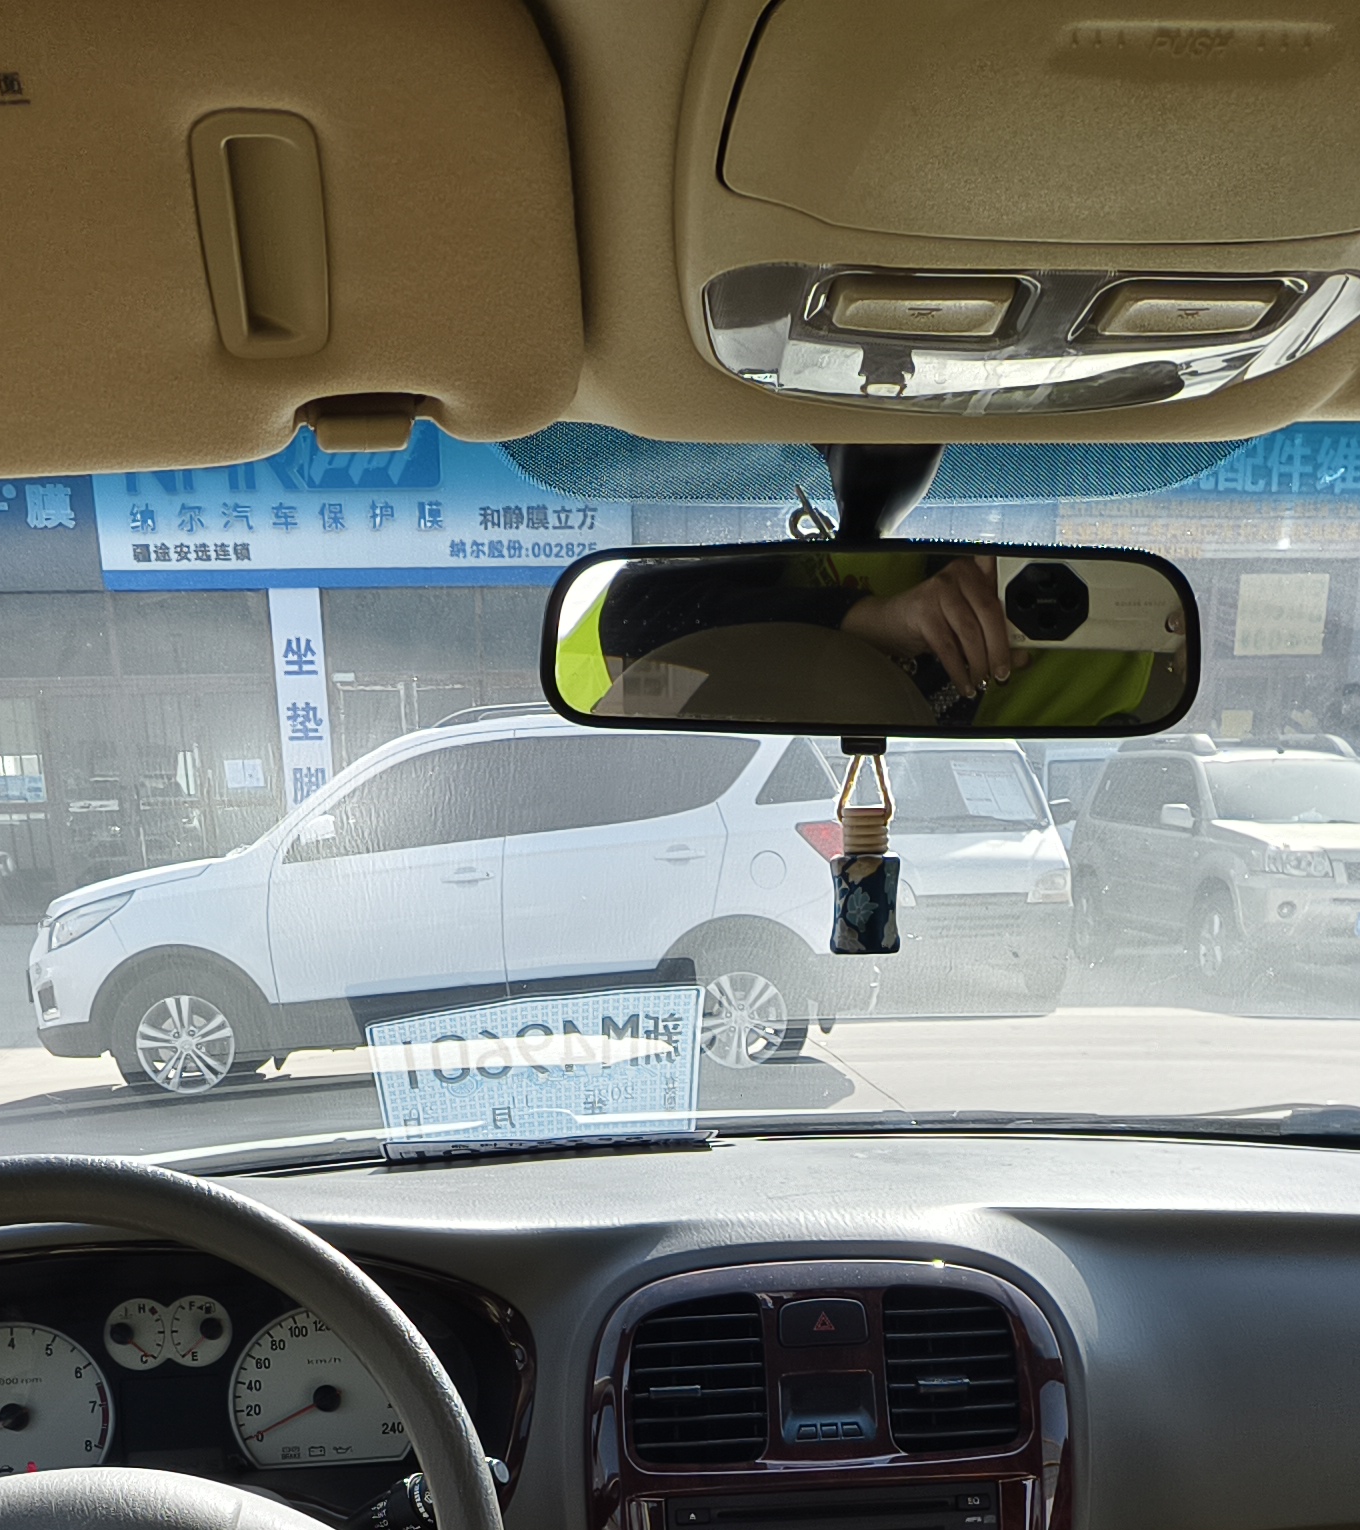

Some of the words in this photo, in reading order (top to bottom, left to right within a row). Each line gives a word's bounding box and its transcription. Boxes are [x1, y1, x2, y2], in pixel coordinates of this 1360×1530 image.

[129, 502, 444, 533] 纳尔汽车保护膜
[478, 504, 598, 531] 和静膜立方
[138, 1304, 145, 1313] H
[289, 1326, 308, 1338] 100
[7, 1338, 16, 1349] 4
[270, 1339, 285, 1351] 80
[45, 1344, 53, 1356] 5
[192, 1351, 198, 1361] E
[256, 1358, 271, 1370] 60
[307, 1356, 342, 1365] km/h
[74, 1367, 82, 1378] 6
[247, 1380, 262, 1391] 40
[89, 1401, 97, 1413] 7
[246, 1404, 261, 1416] 20
[382, 1422, 404, 1434] 240
[84, 1440, 93, 1452] 8
